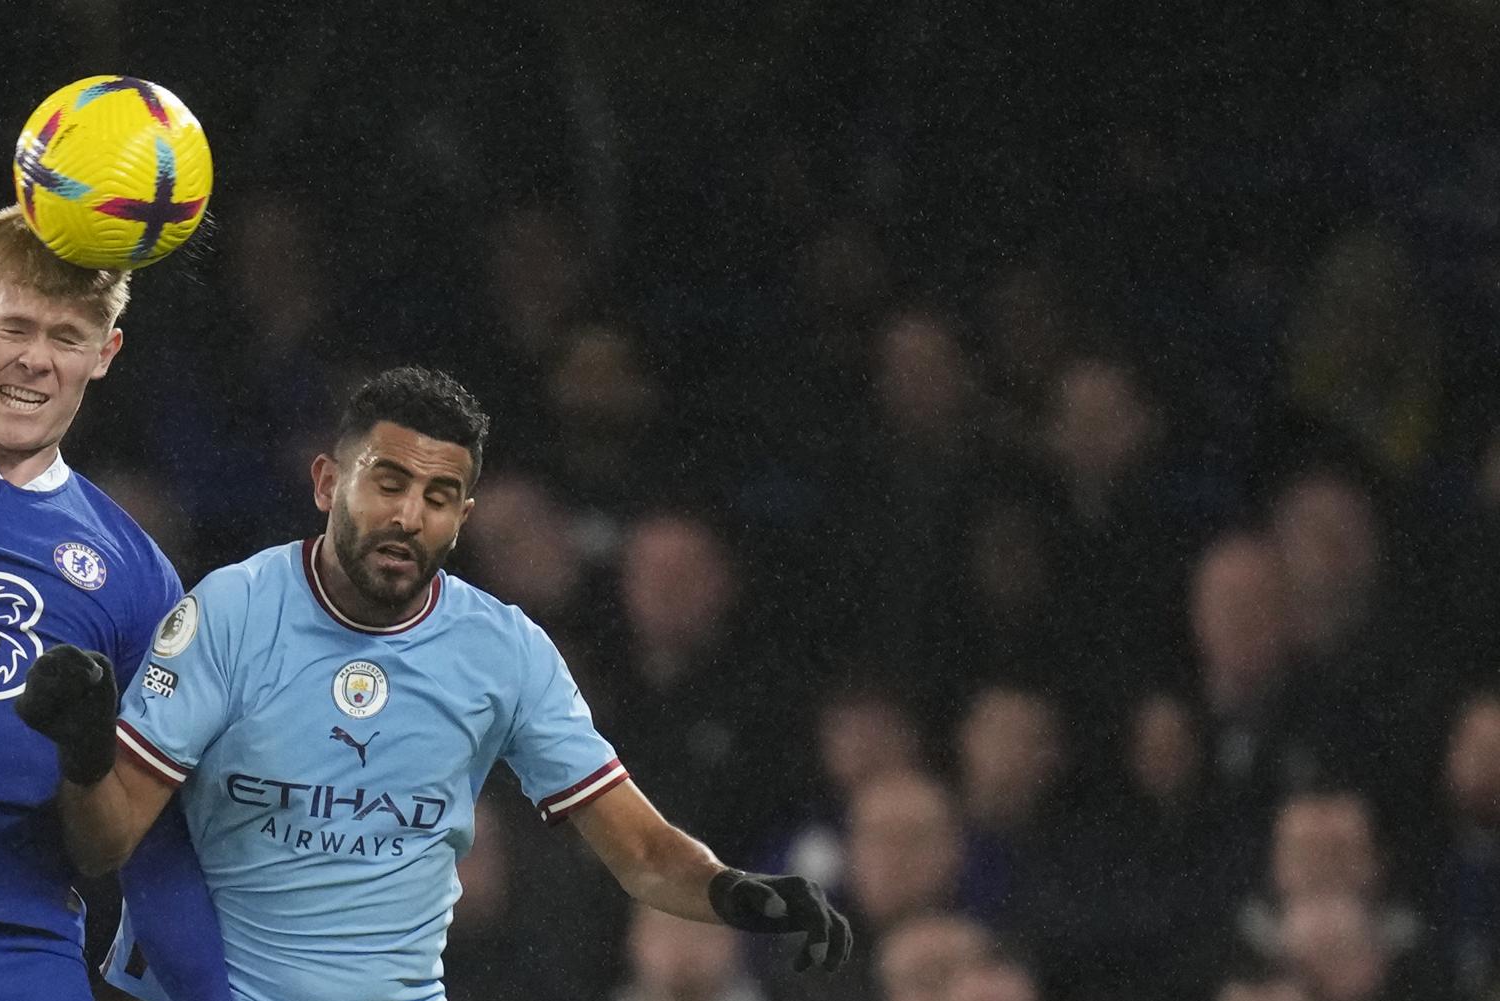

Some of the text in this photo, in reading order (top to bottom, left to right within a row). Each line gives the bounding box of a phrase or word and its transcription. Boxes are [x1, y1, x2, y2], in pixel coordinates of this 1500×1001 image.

[66, 543, 100, 562] CHELSEA
[340, 663, 384, 684] MANCHESTER
[349, 707, 366, 715] CITY
[226, 774, 446, 830] ETIHAD
[260, 816, 404, 857] AIRWAYS
